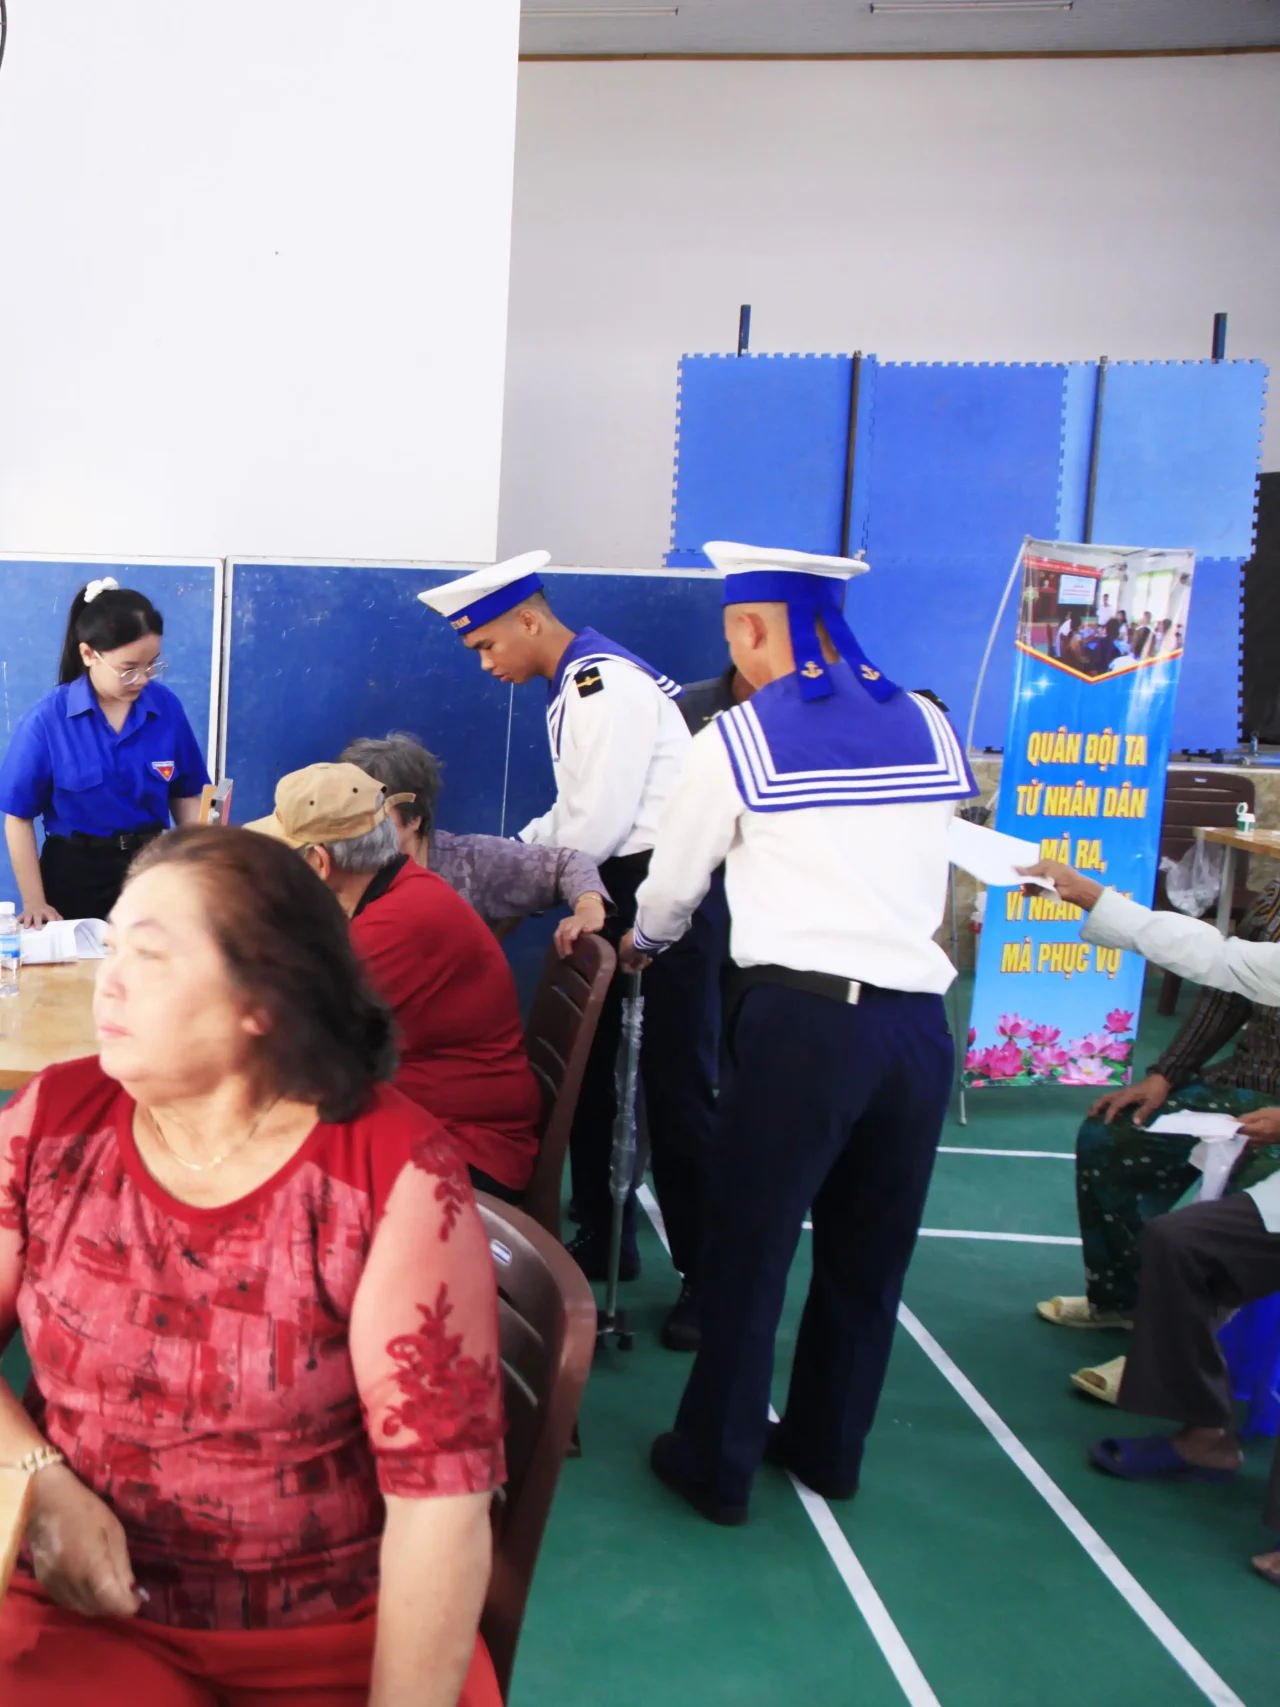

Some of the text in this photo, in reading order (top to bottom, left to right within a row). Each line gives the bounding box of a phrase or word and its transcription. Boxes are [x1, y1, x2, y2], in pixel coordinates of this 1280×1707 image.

[1026, 725, 1148, 772] QUÂN ĐỘI TA
[1016, 778, 1148, 819] TỪ NHÂN DÂN
[1074, 838, 1108, 874] RA,
[1000, 935, 1123, 980] MÀ PHỤC VỤ
